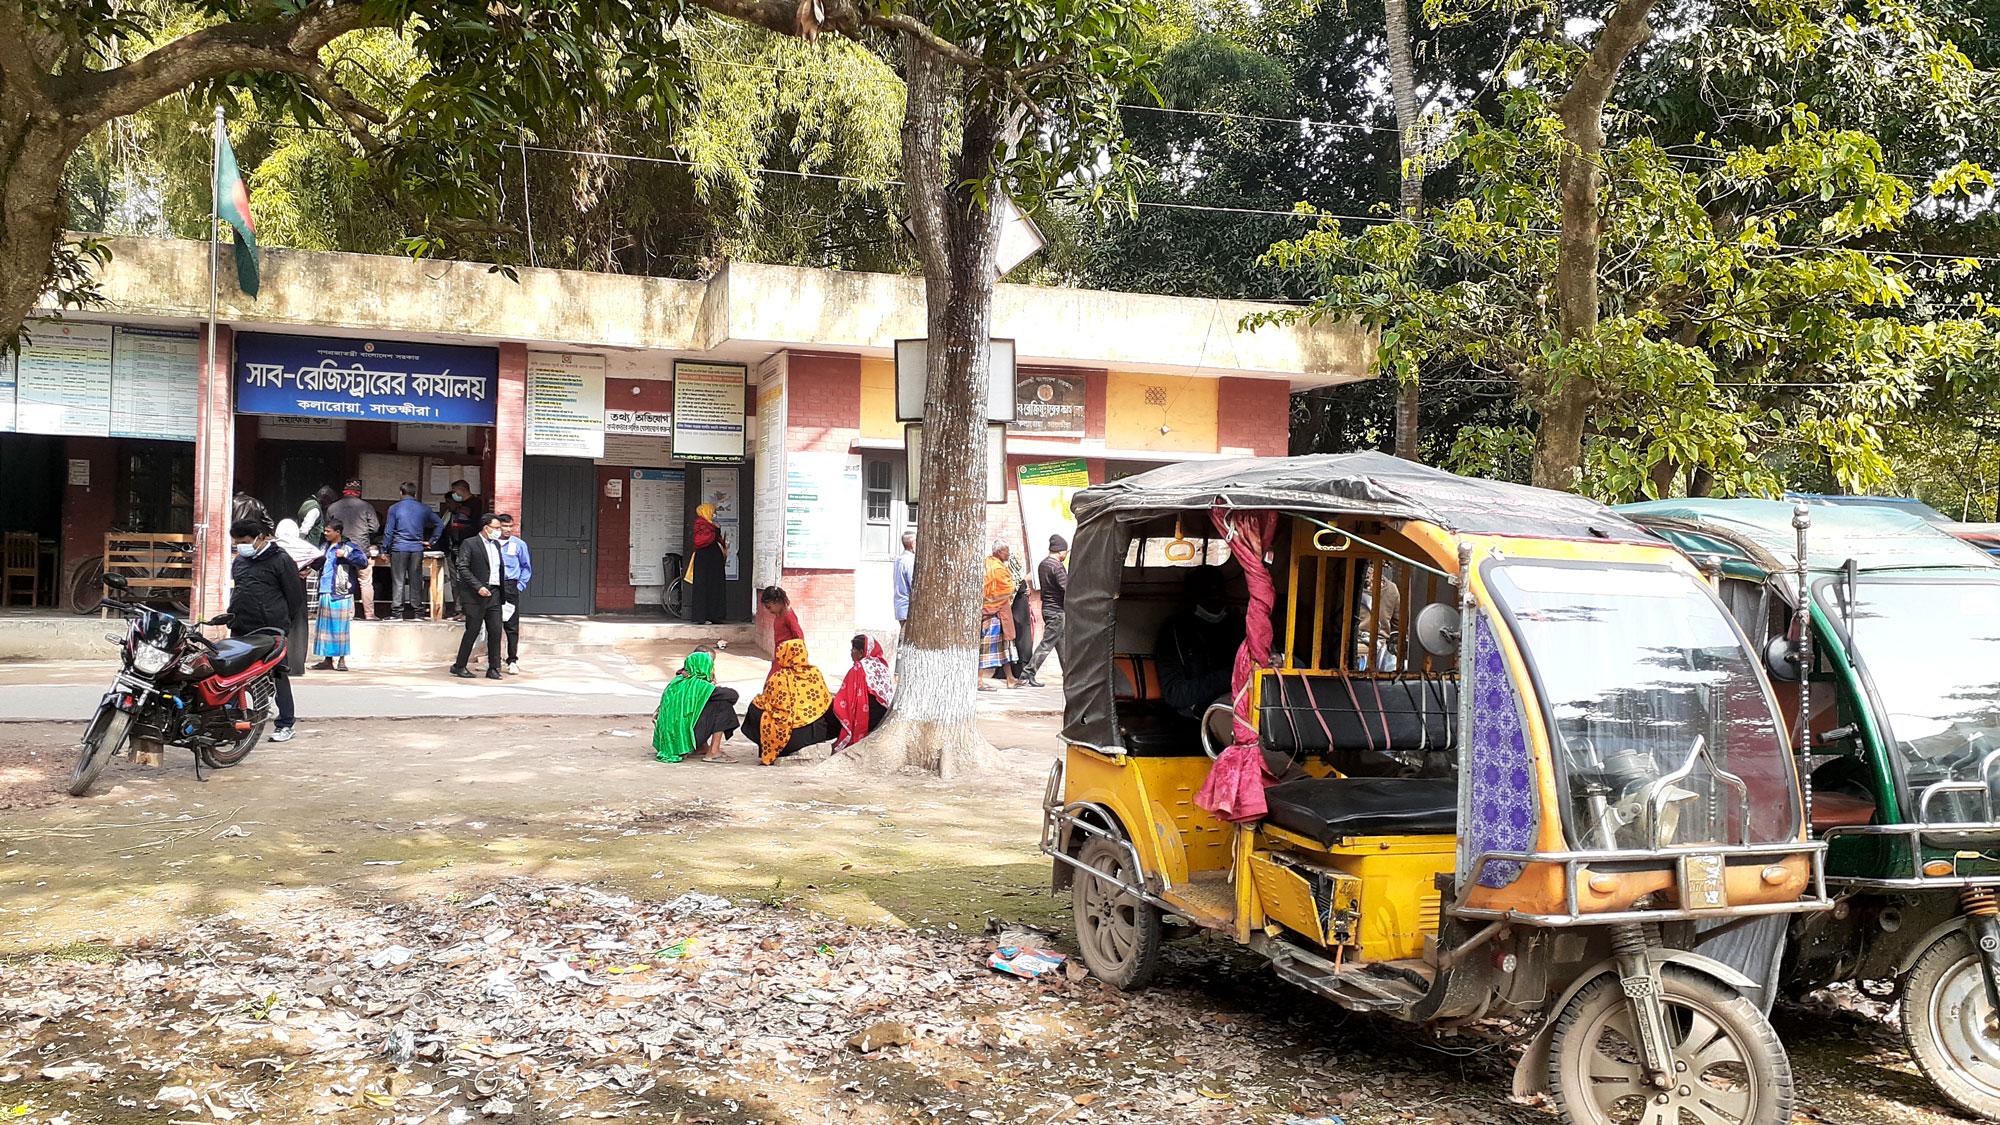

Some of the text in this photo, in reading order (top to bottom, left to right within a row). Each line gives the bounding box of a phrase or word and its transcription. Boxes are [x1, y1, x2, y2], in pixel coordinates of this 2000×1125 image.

[246, 359, 487, 401] সাব-রেজিস্ট্রারের কার্যালয়
[296, 400, 365, 416] কলারোয়া,
